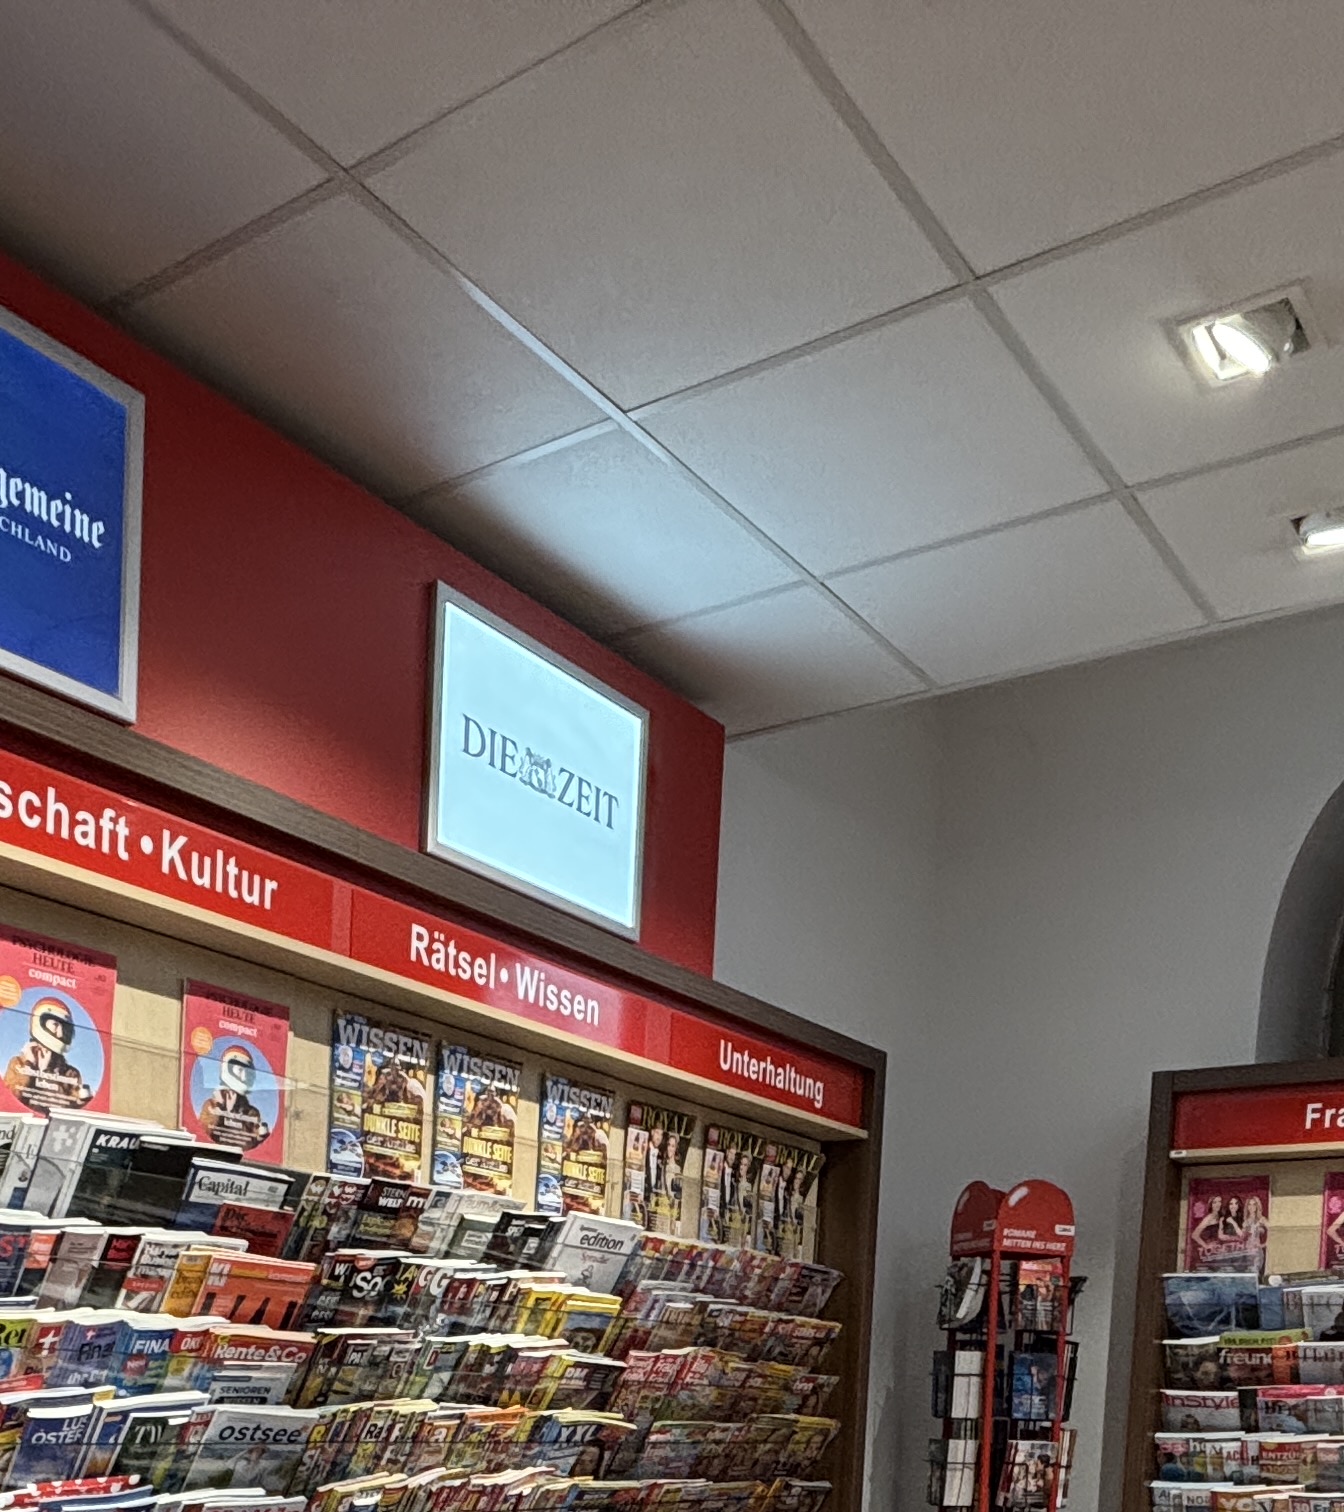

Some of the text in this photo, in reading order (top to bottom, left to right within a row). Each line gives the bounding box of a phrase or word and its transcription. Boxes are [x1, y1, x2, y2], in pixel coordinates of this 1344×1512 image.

[460, 712, 620, 831] DIE ZEIT
[160, 830, 278, 911] Kultur
[409, 921, 601, 1026] Rätsel Wissen
[337, 1014, 429, 1065] WISSEN
[442, 1047, 521, 1092] WISSEN
[718, 1038, 826, 1108] Unterhaltung
[197, 1175, 250, 1198] Capital
[579, 1231, 625, 1252] edition
[218, 1421, 302, 1445] ostsee
